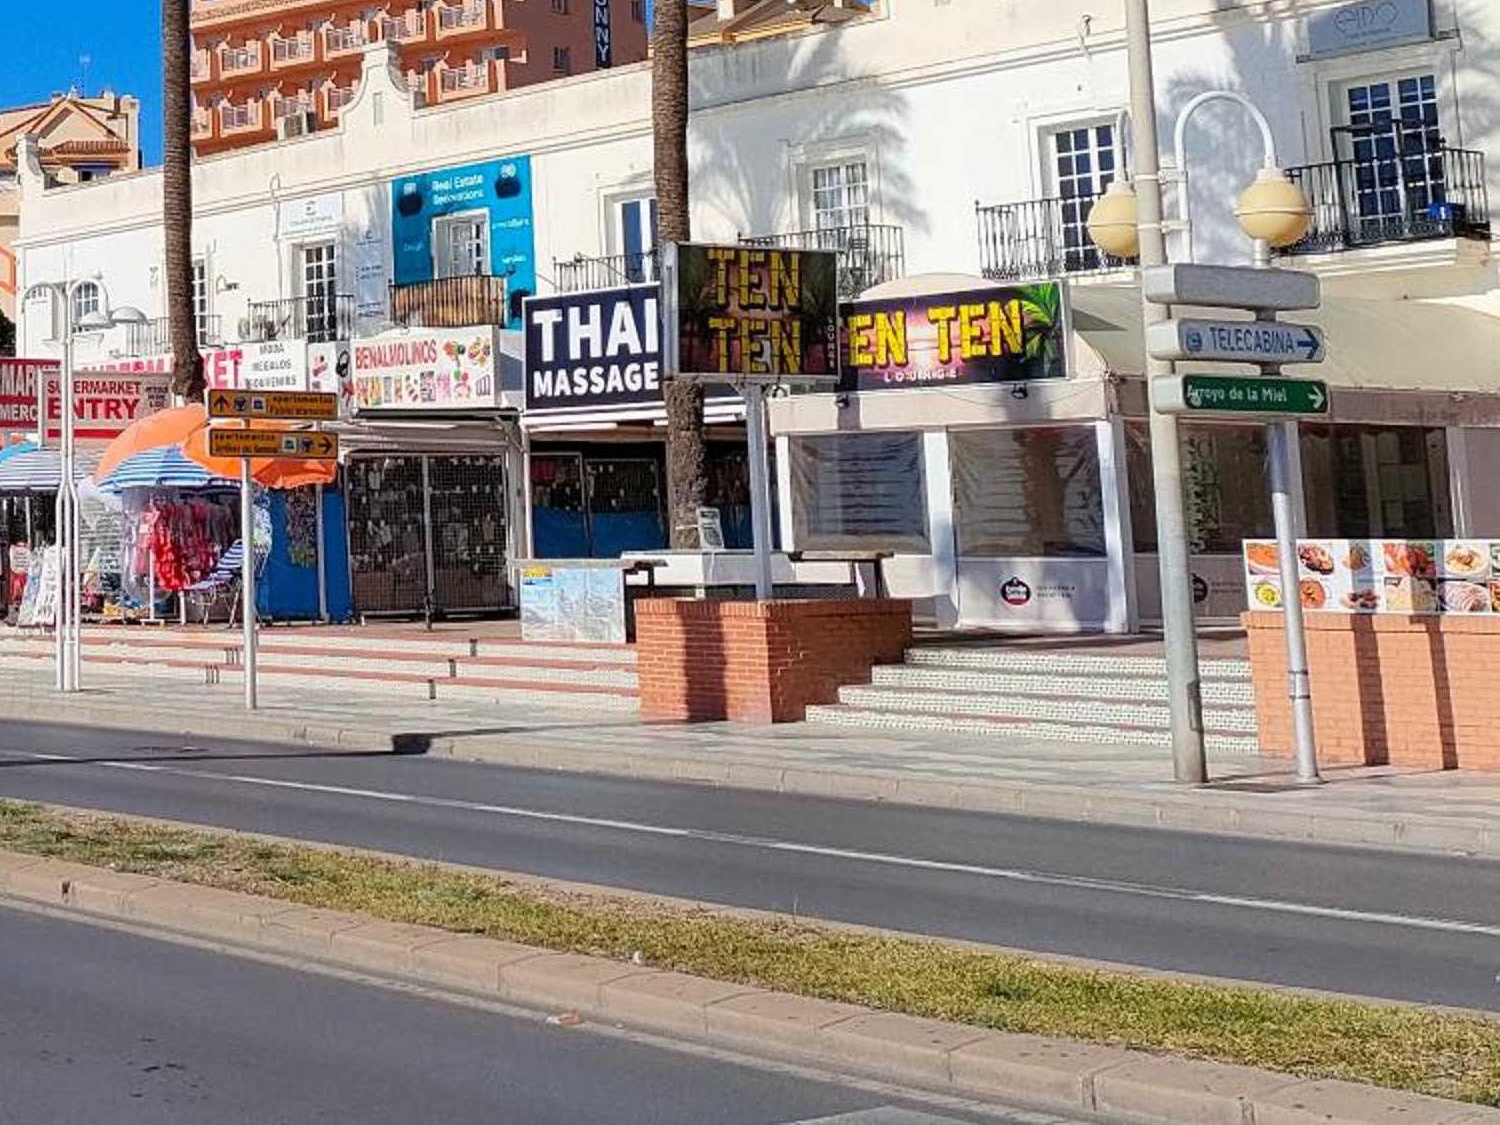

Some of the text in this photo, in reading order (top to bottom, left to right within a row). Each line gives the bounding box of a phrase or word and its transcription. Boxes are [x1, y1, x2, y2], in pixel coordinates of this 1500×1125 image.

[707, 248, 800, 306] TEN
[532, 298, 659, 363] THAI
[707, 317, 801, 373] TEN
[848, 299, 1024, 366] EN TEN
[1209, 327, 1296, 354] TELECABINA
[533, 361, 659, 398] MASSAGE
[1187, 384, 1288, 402] Arroyo de la Miel
